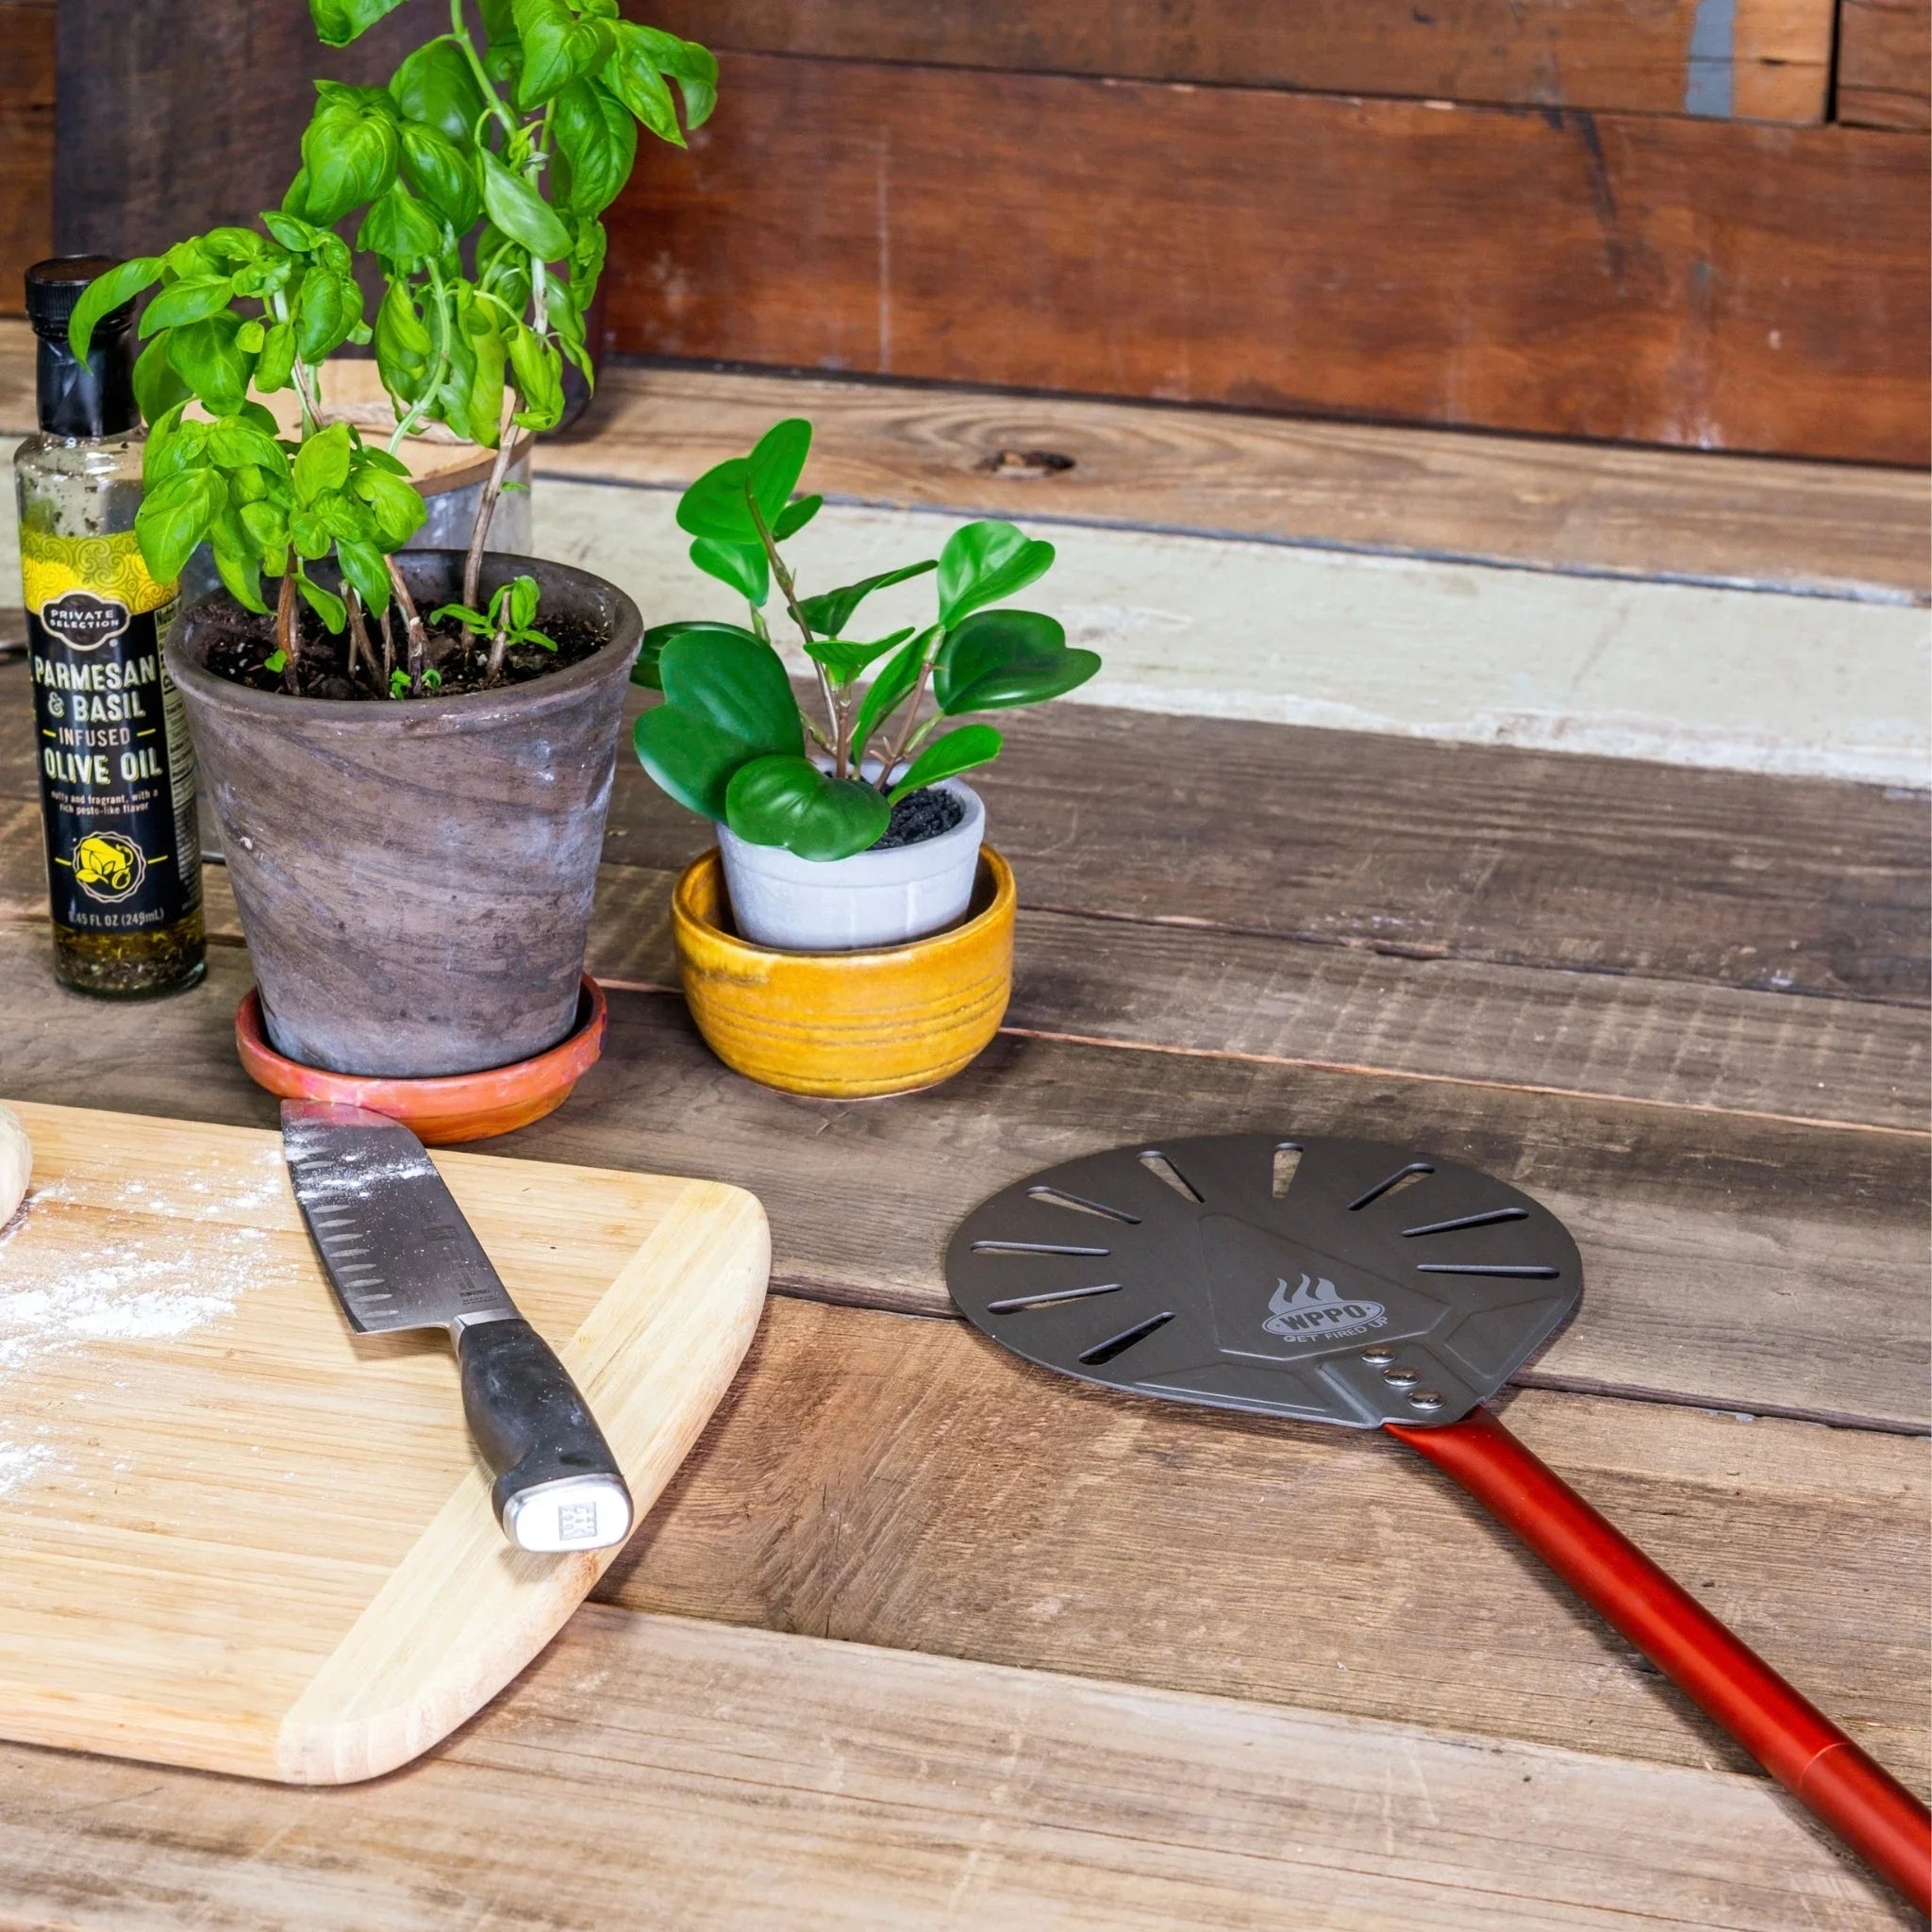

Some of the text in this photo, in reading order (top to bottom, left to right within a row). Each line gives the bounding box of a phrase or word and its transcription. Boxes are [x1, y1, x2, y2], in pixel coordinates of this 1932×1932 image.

[50, 619, 119, 629] SELECTION
[51, 609, 114, 621] PRIVATE
[35, 655, 158, 691] PARMESAN
[48, 691, 146, 723] & BASIL
[58, 726, 131, 747] INFUSED
[44, 746, 163, 785] OLIVE OIL
[71, 795, 85, 804] and
[131, 790, 150, 801] with
[76, 806, 120, 815] pesto-like
[123, 802, 149, 813] flavor
[90, 914, 102, 926] FL
[105, 915, 119, 926] OZ
[1279, 1305, 1368, 1330] WPPO
[1283, 1316, 1389, 1342] GET FIRED UP
